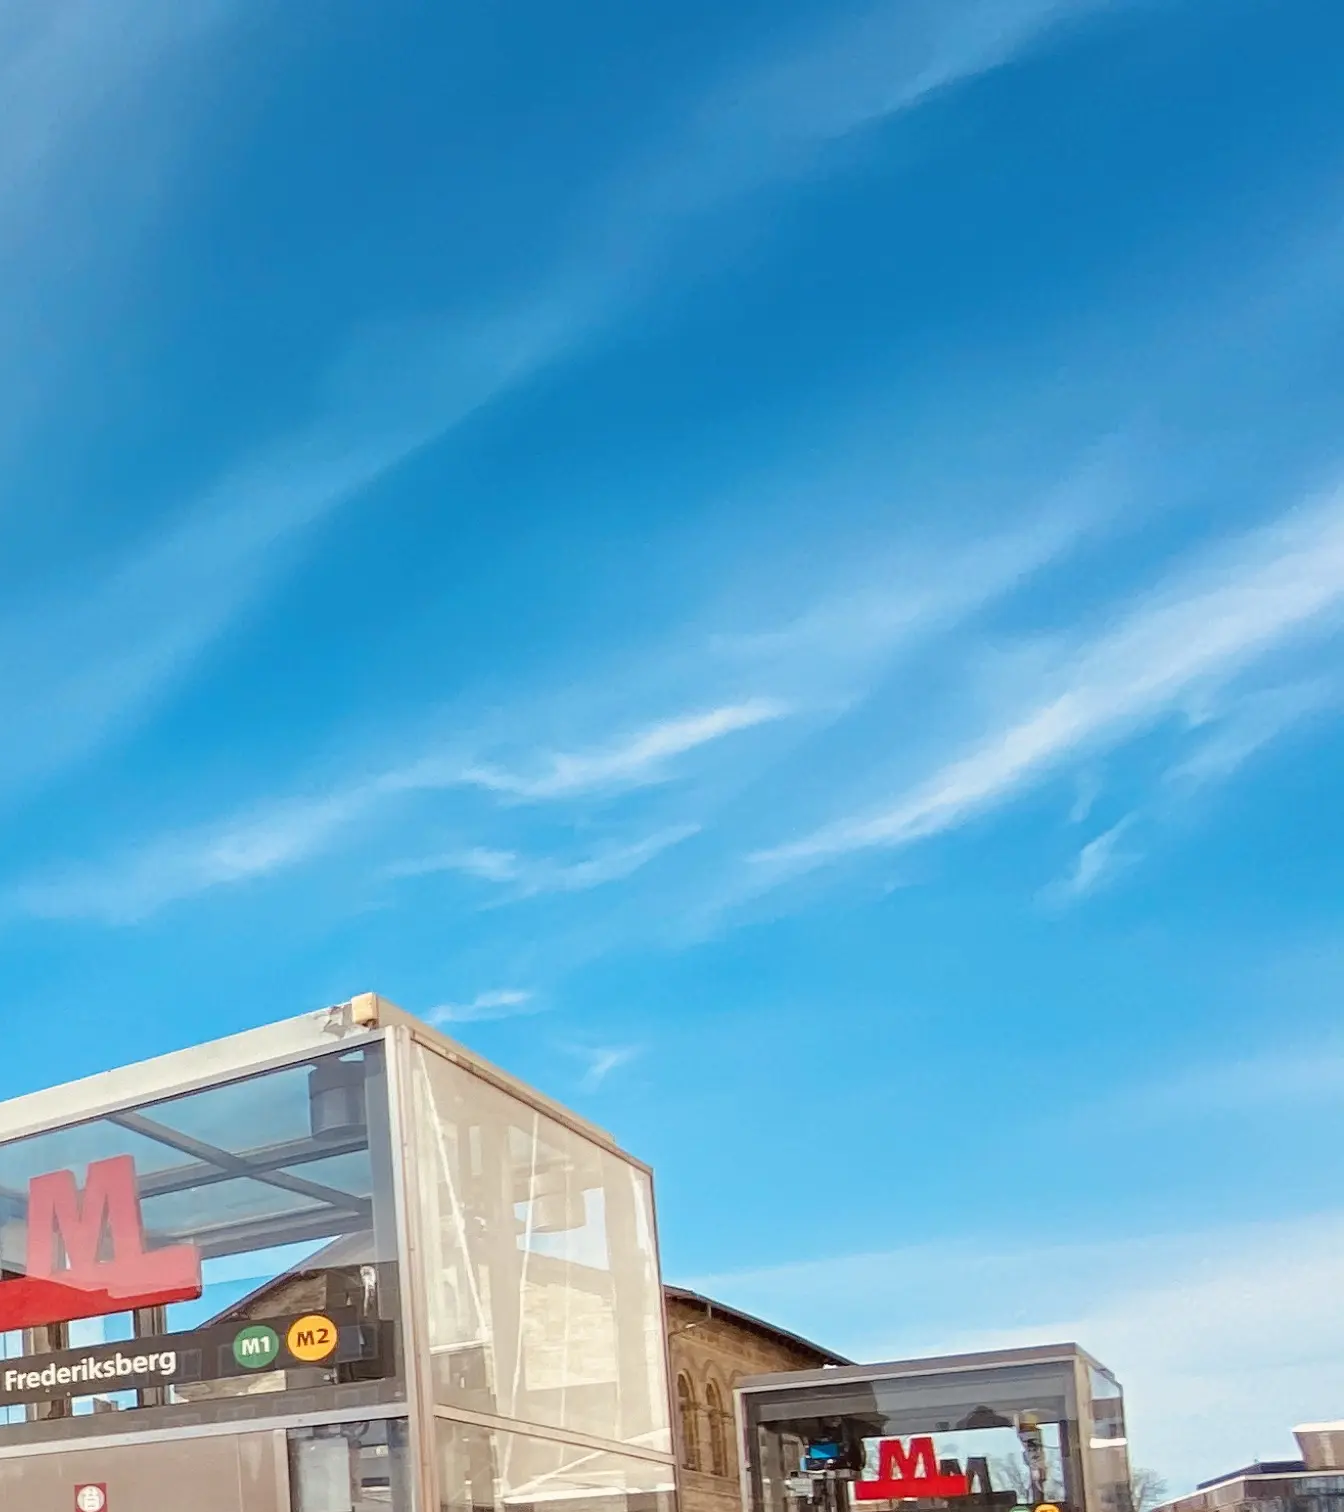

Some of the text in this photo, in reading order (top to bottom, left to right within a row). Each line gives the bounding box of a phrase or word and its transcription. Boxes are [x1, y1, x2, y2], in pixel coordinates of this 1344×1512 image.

[4, 1327, 330, 1392] Frederiksberg M1 M2
[879, 1437, 939, 1481] M
